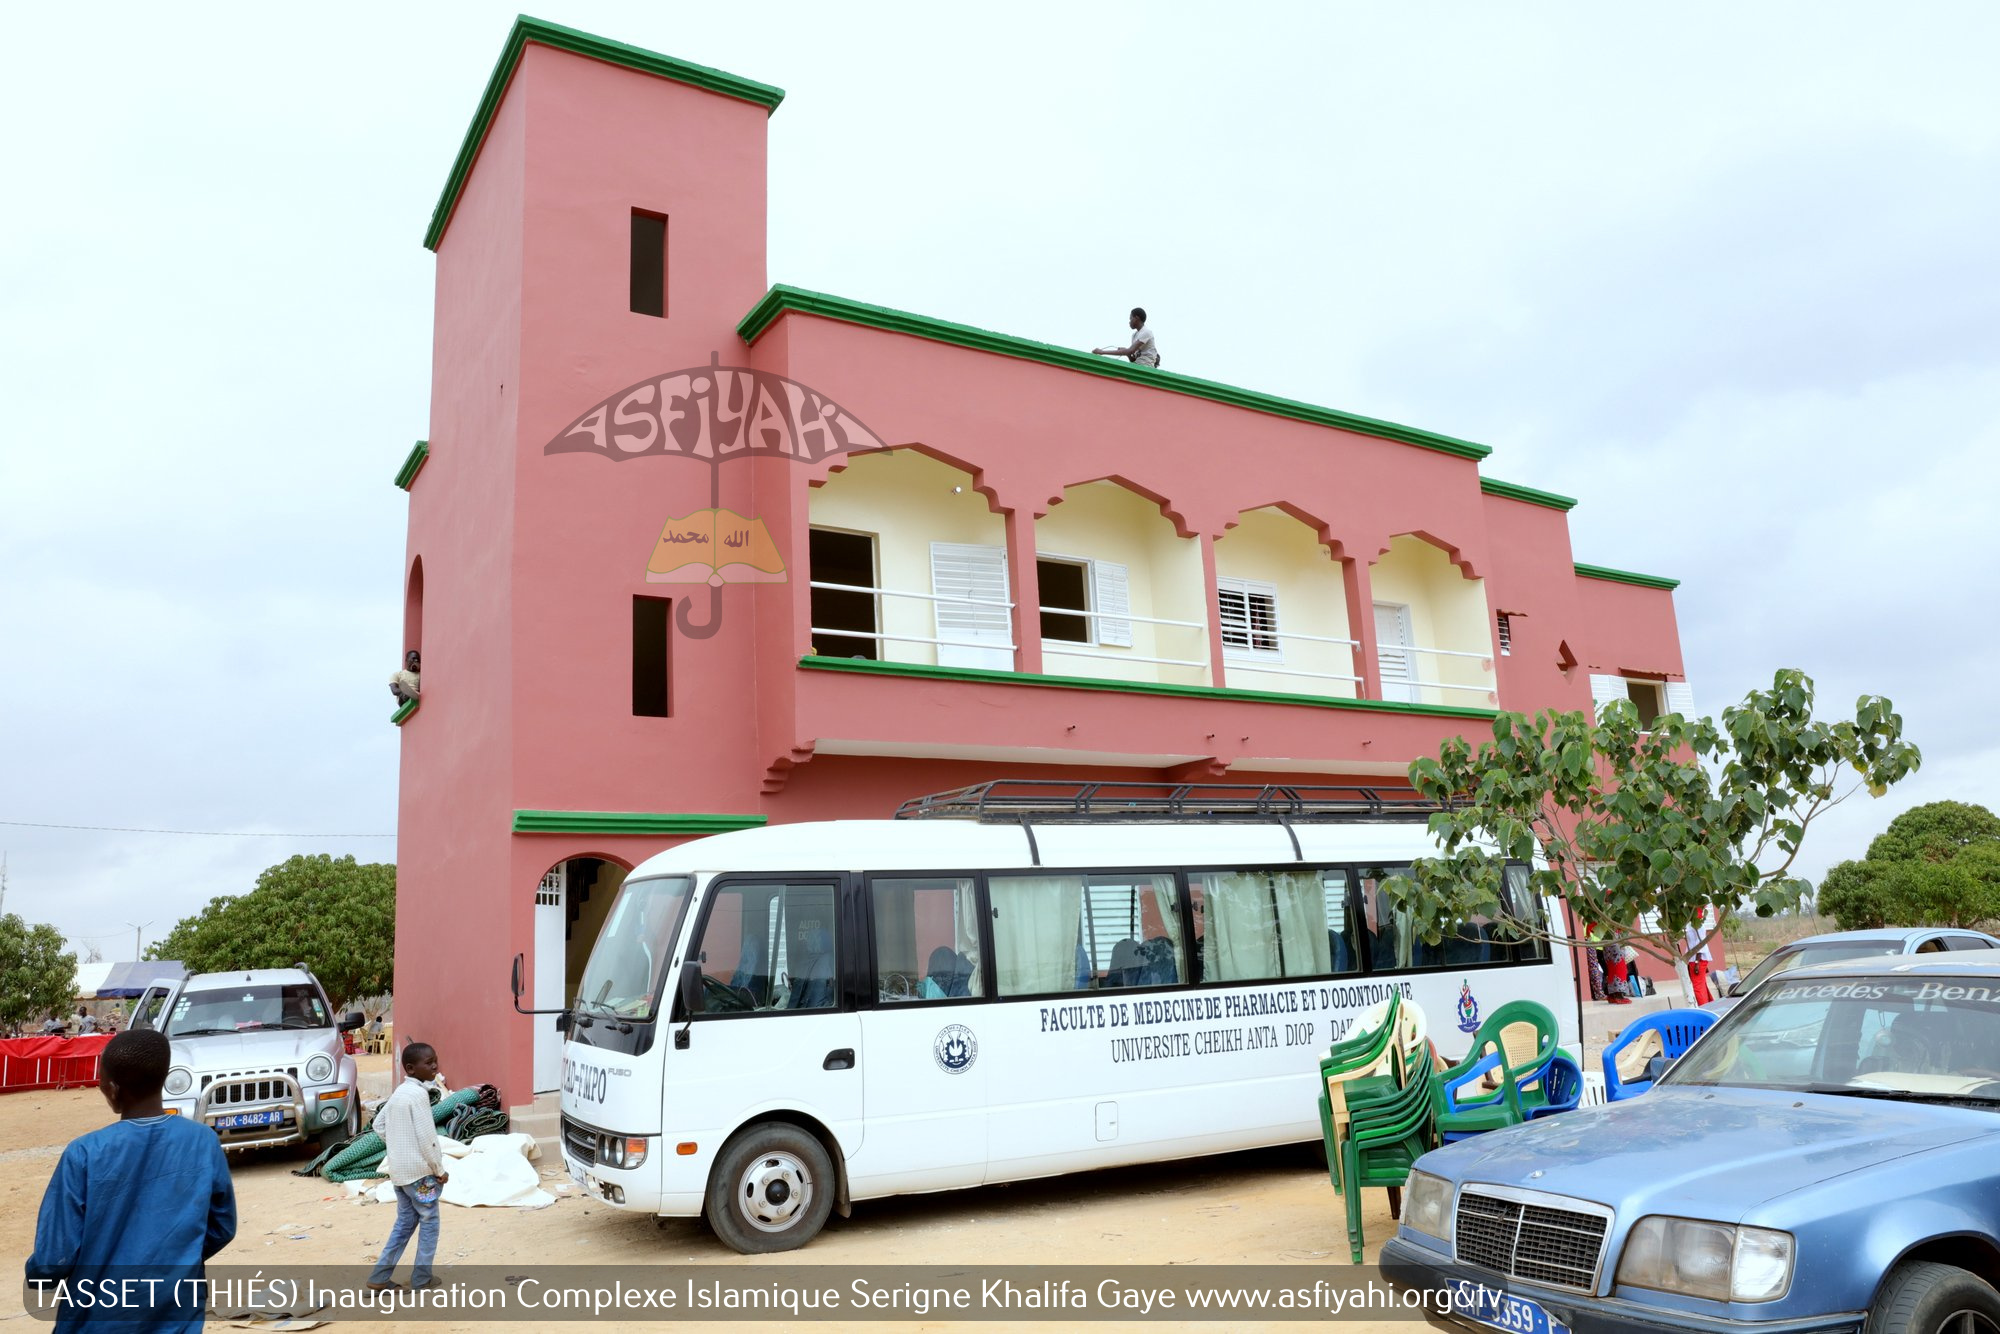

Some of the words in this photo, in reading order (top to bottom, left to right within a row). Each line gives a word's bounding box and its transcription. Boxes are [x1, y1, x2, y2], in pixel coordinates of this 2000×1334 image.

[1759, 981, 1891, 1001] Mercedes
[1040, 1004, 1106, 1032] FACULTE
[1109, 1003, 1130, 1027] DE
[1133, 998, 1204, 1026] MEDECINE
[1204, 996, 1222, 1020] DE
[1225, 990, 1298, 1018] PHARMACIE
[1302, 989, 1317, 1012] ET
[1321, 982, 1413, 1010] D'ODONTOLOIE
[1111, 1033, 1191, 1063] UNIVERSITE
[1194, 1028, 1242, 1056] CHEIKH
[1247, 1025, 1278, 1050] ANTA
[1285, 1022, 1315, 1047] DIOP
[608, 1067, 632, 1078] FUSO
